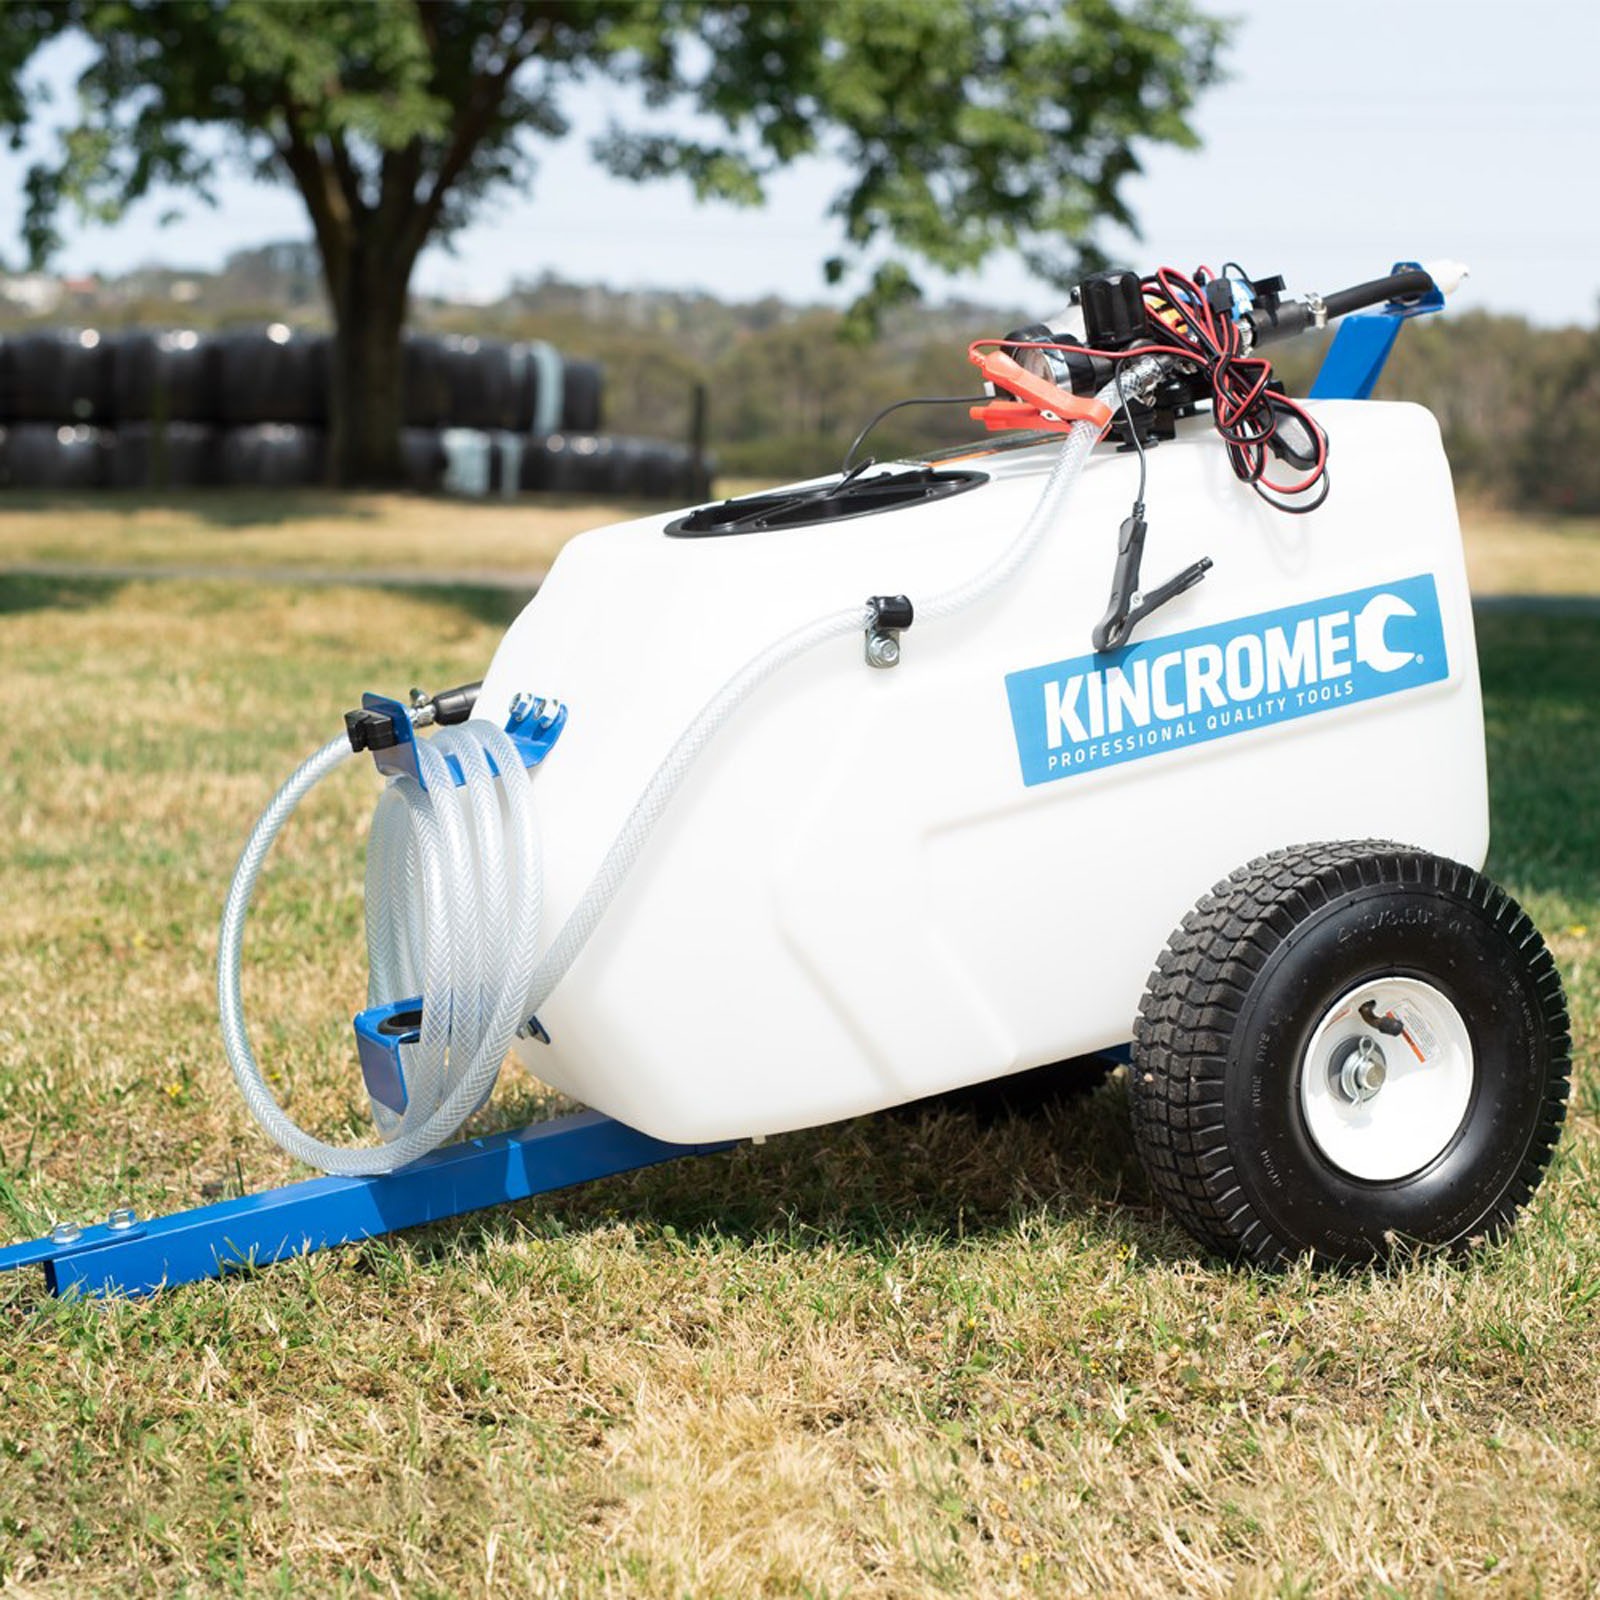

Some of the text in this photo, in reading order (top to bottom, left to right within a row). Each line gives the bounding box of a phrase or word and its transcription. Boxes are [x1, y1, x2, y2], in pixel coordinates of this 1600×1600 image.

[1044, 611, 1351, 748] KINCROME
[1049, 682, 1354, 769] PROFESSIONAL QUALITY TOOLS
